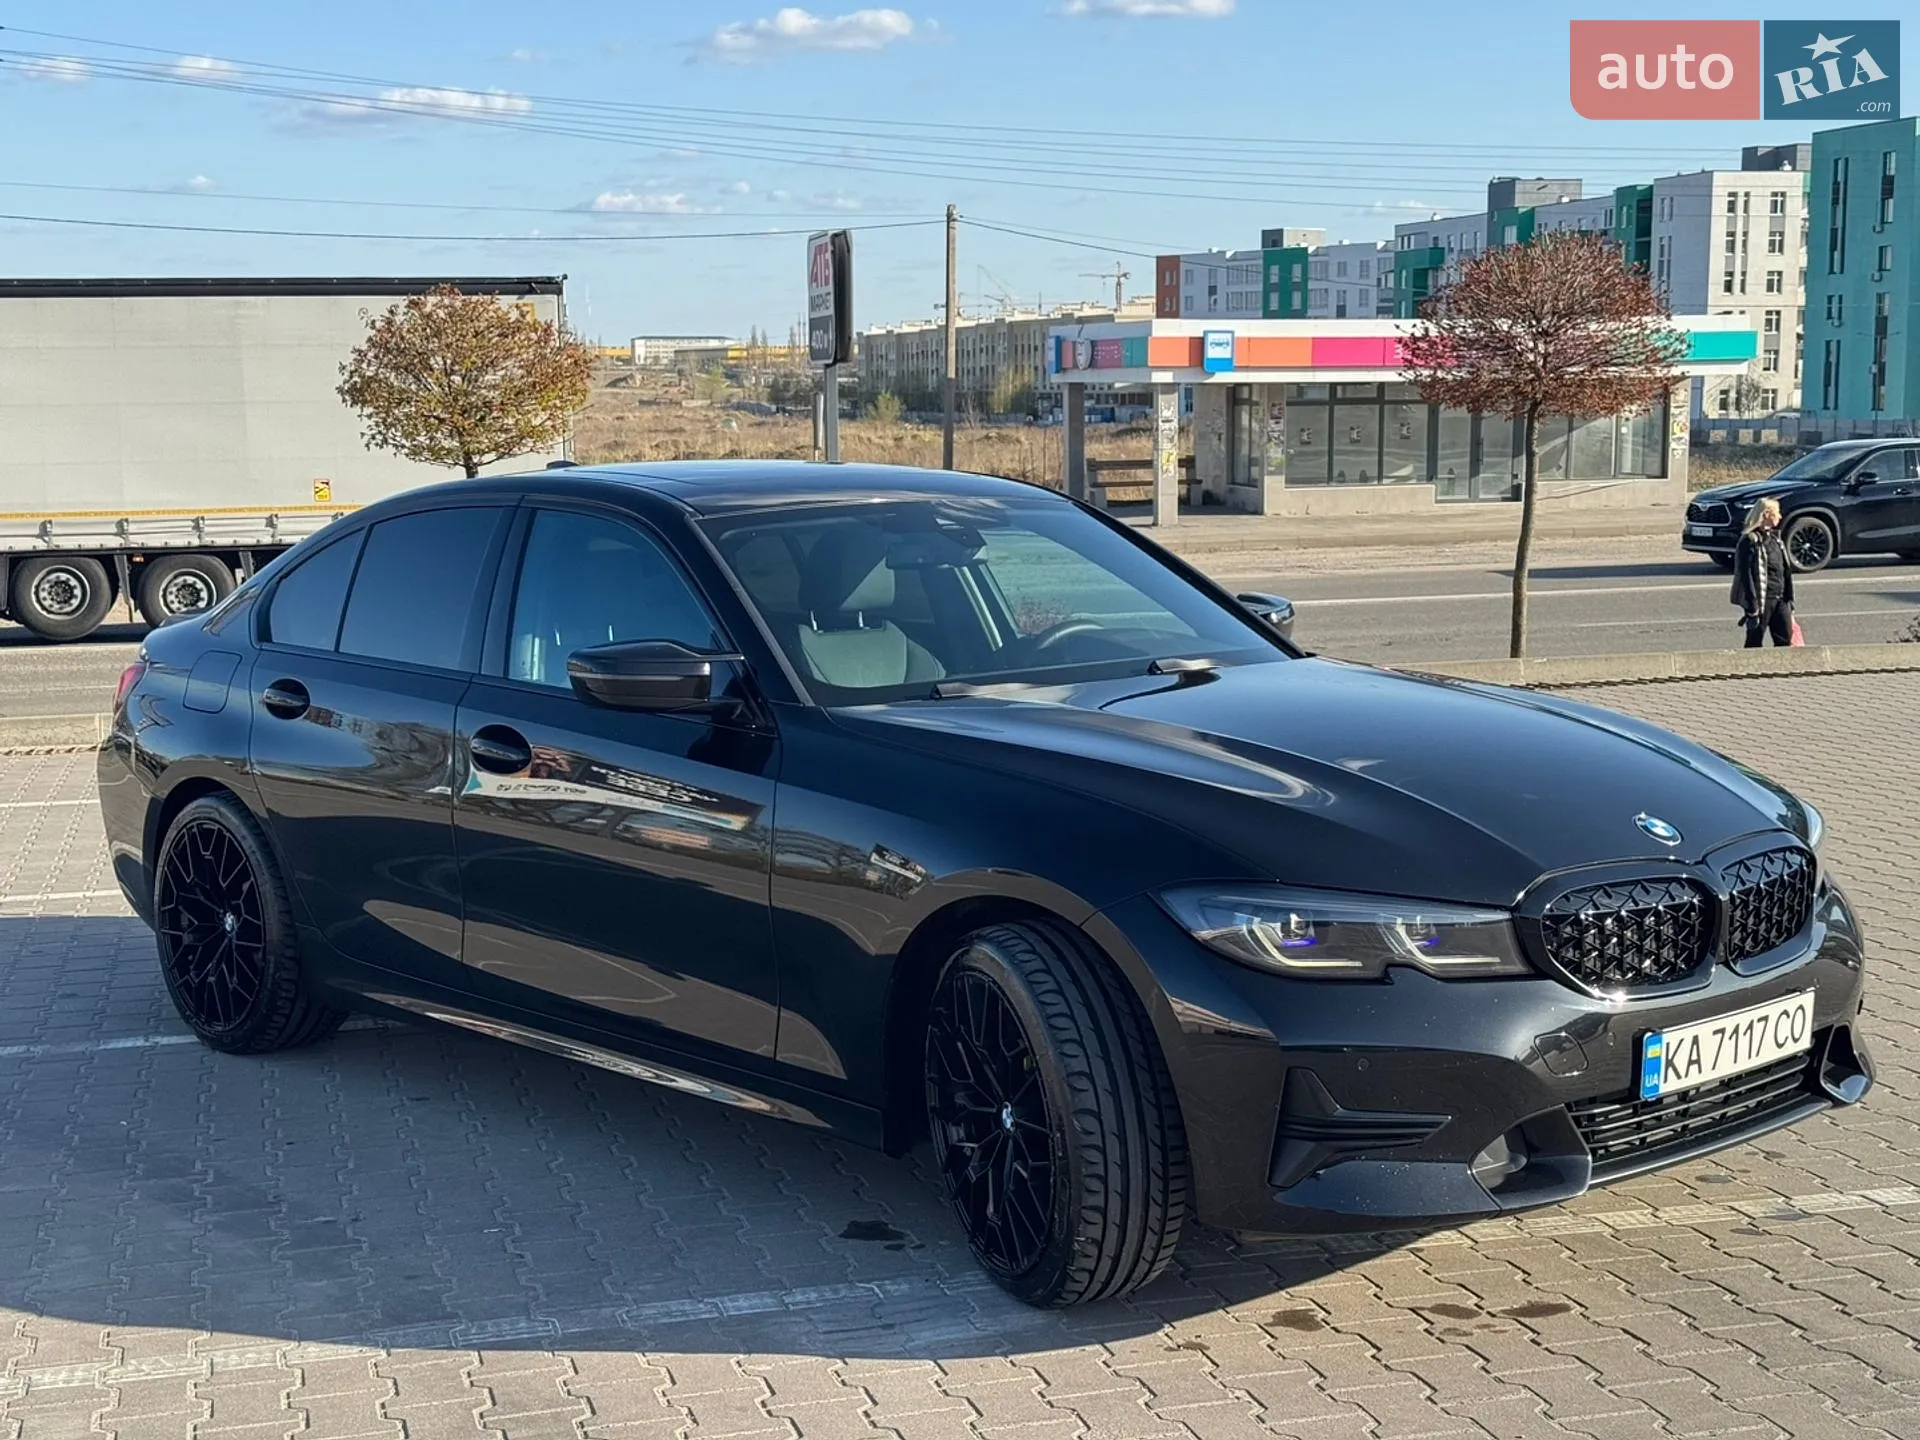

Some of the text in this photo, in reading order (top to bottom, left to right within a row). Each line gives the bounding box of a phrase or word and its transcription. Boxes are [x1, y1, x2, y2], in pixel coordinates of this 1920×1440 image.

[1663, 1003, 1806, 1084] KA 7117 CO
[1645, 1073, 1659, 1088] UA
